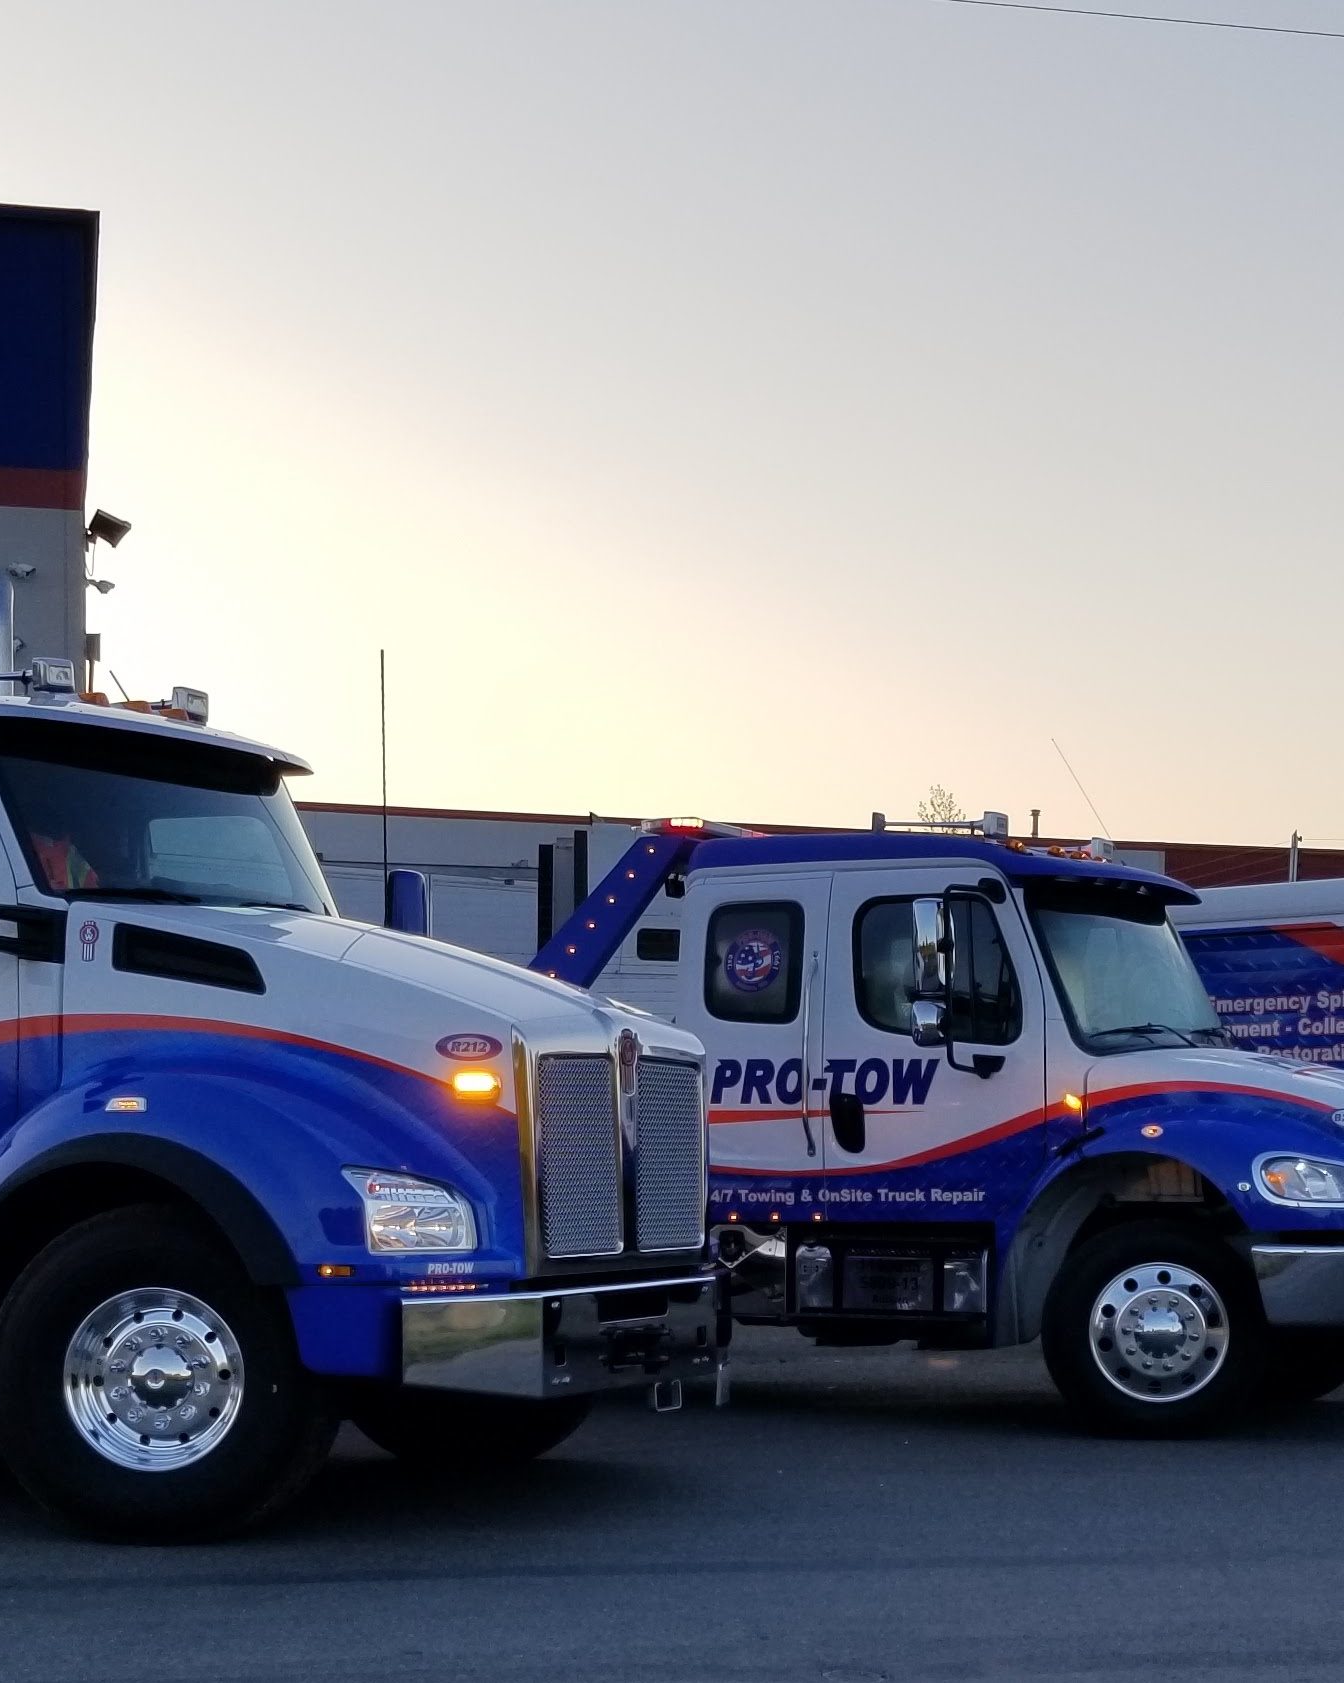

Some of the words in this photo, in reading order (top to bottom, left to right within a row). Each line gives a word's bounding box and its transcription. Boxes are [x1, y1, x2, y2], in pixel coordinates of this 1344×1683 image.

[1210, 995, 1312, 1015] mergency
[451, 1041, 487, 1053] R212
[709, 1058, 941, 1105] PRO-TOW
[738, 1189, 795, 1205] Towing
[799, 1189, 813, 1203] &
[818, 1188, 873, 1203] OnSite
[877, 1188, 926, 1203] Truck
[930, 1188, 986, 1206] Repair
[427, 1262, 474, 1275] PRO-TOW
